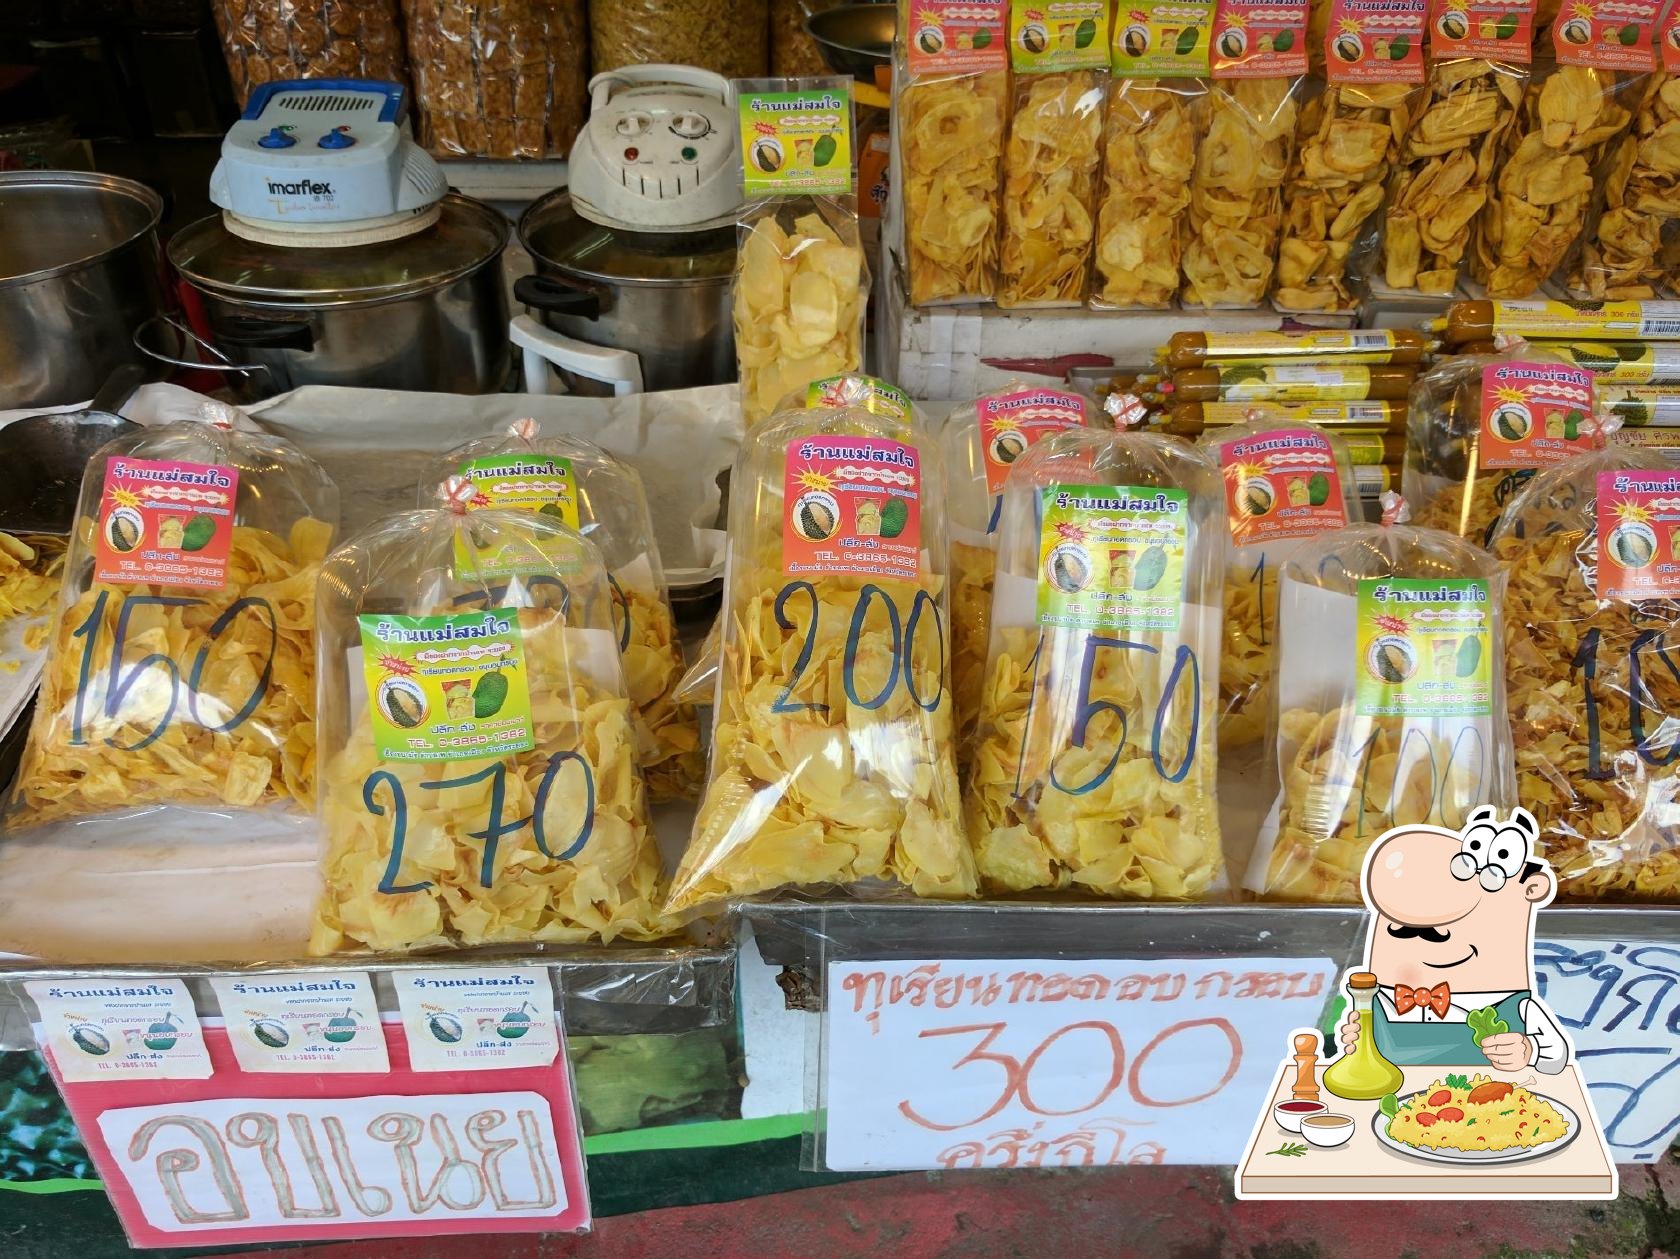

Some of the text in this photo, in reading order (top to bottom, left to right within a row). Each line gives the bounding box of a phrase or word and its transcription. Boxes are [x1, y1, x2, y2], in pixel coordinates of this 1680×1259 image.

[751, 95, 842, 112] ร้านแม่สมใจ
[265, 176, 332, 195] imarflex
[1495, 367, 1590, 387] ร้านแม่สมใจ
[988, 394, 1081, 412] ร้านแม่สมใจ
[800, 443, 914, 468] ร้านแม่สมใจ
[1233, 435, 1328, 457] ร้านแม่สมใจ
[114, 463, 230, 487] ร้านแม่สมใจ
[1056, 493, 1179, 513] ร้านแม่สมใจ
[814, 551, 839, 561] TEL.
[1374, 585, 1486, 603] ร้านแม่สมใจ
[377, 616, 510, 642] ร้านแม่สมใจ
[770, 581, 944, 714] 200
[68, 590, 277, 751] 150
[1010, 634, 1200, 800] 150
[407, 728, 526, 749] TEL. 0-3865-1382
[1352, 726, 1484, 839] 100
[363, 750, 595, 894] 270
[49, 985, 174, 998] ร้านแม่สมใจ
[233, 979, 356, 994] ร้านแม่สมใจ
[413, 975, 535, 988] ร้านแม่สมใจ
[898, 1016, 1243, 1131] 300
[128, 1109, 556, 1224] อบเนย
